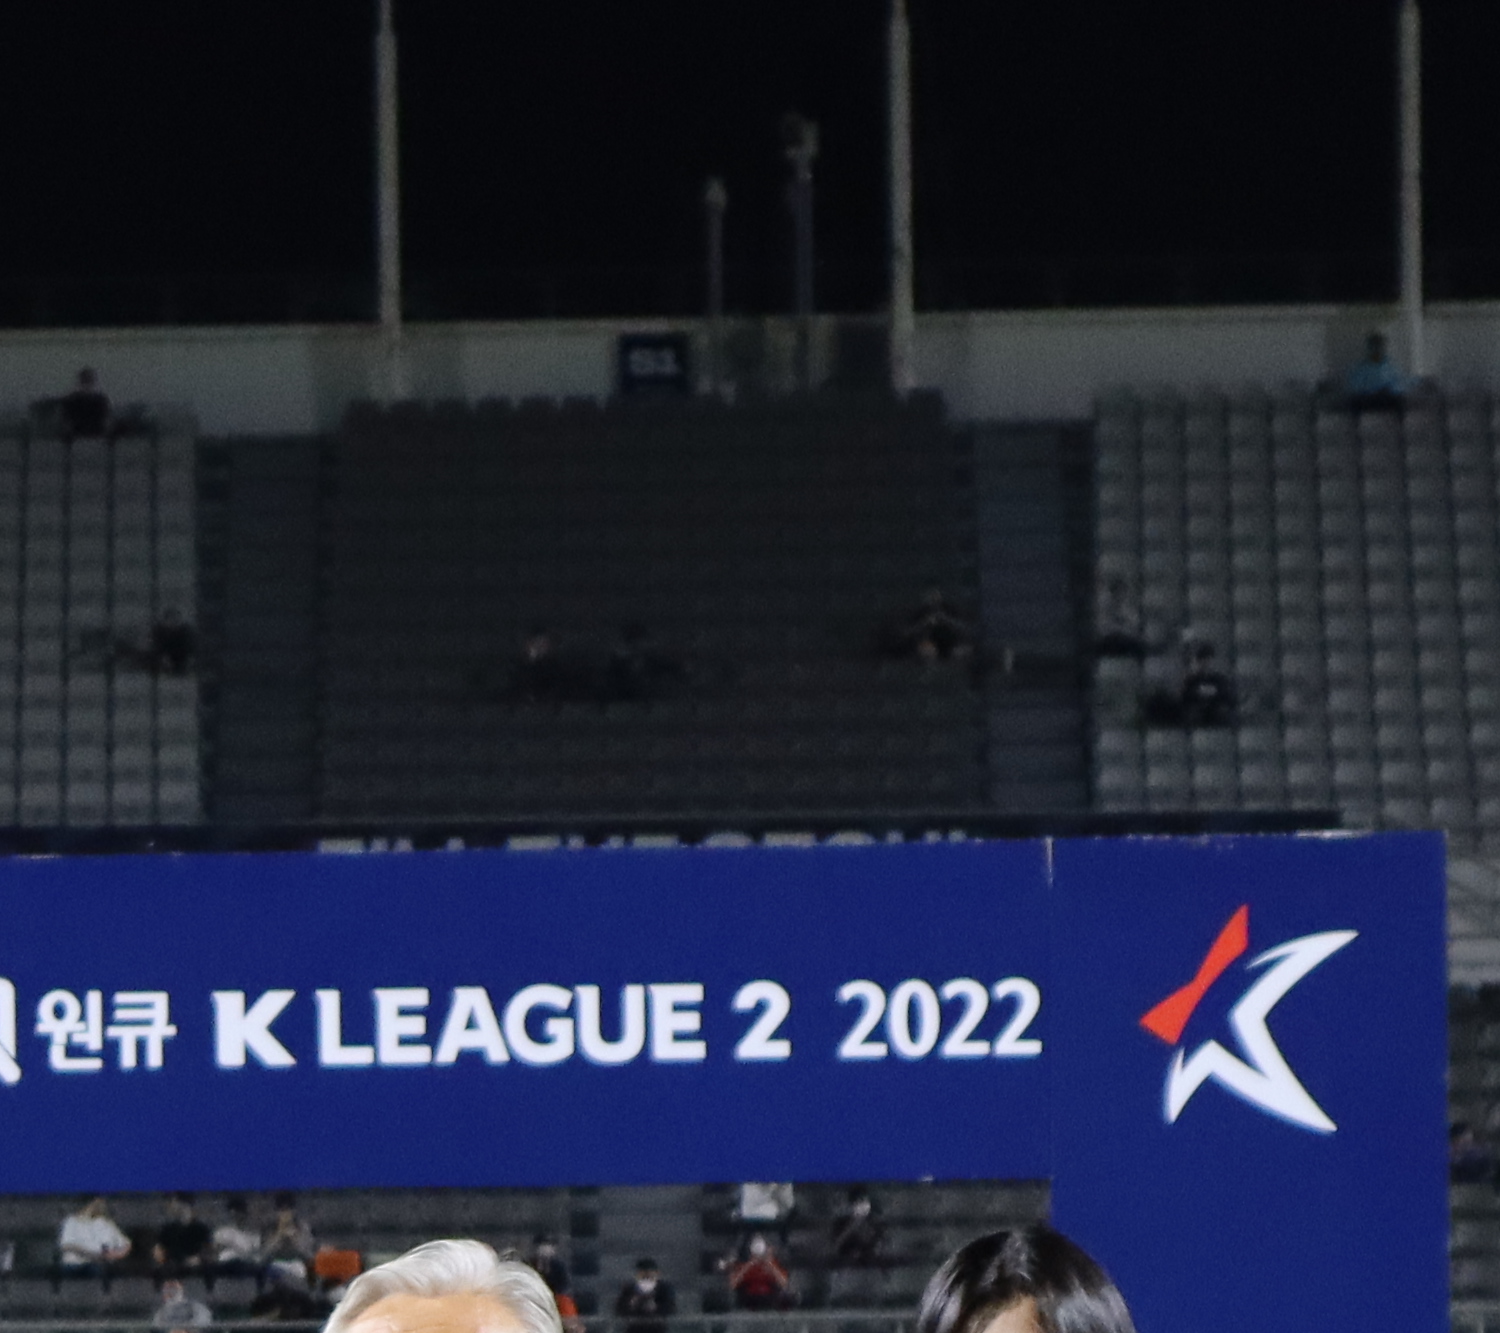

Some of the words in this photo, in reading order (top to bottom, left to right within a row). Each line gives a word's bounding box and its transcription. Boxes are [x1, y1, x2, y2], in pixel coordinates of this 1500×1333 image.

[35, 989, 177, 1070] 원큐
[213, 989, 297, 1068] K
[315, 983, 706, 1066] LEAGUE
[732, 980, 792, 1060] 2
[836, 977, 1043, 1060] 2022
